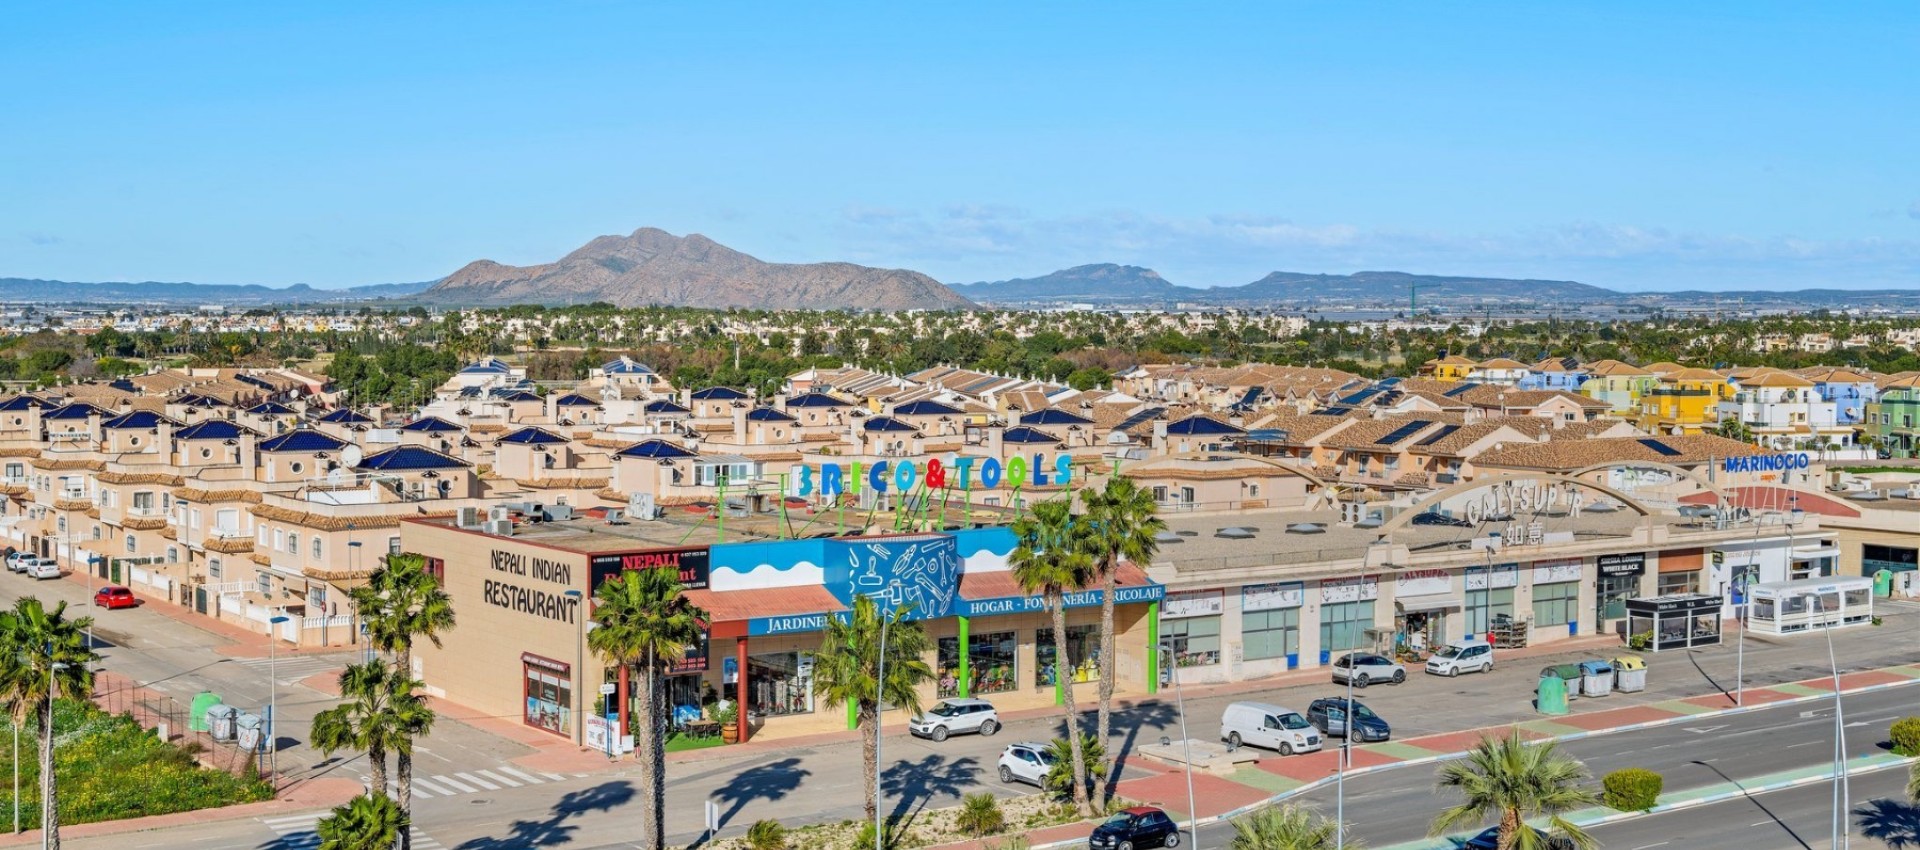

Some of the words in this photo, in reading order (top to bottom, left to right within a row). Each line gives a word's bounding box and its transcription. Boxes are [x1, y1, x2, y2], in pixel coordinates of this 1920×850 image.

[1726, 453, 1808, 473] MARINOCIO
[1506, 521, 1544, 546] 如意
[491, 549, 527, 576] NEPALI
[532, 557, 571, 585] INDIAN
[622, 553, 680, 570] NEPALI
[1621, 563, 1639, 571] BLACK
[484, 579, 578, 624] RESTAURANT
[971, 601, 1013, 614] HOGAR
[1112, 586, 1162, 602] RICOLAJE
